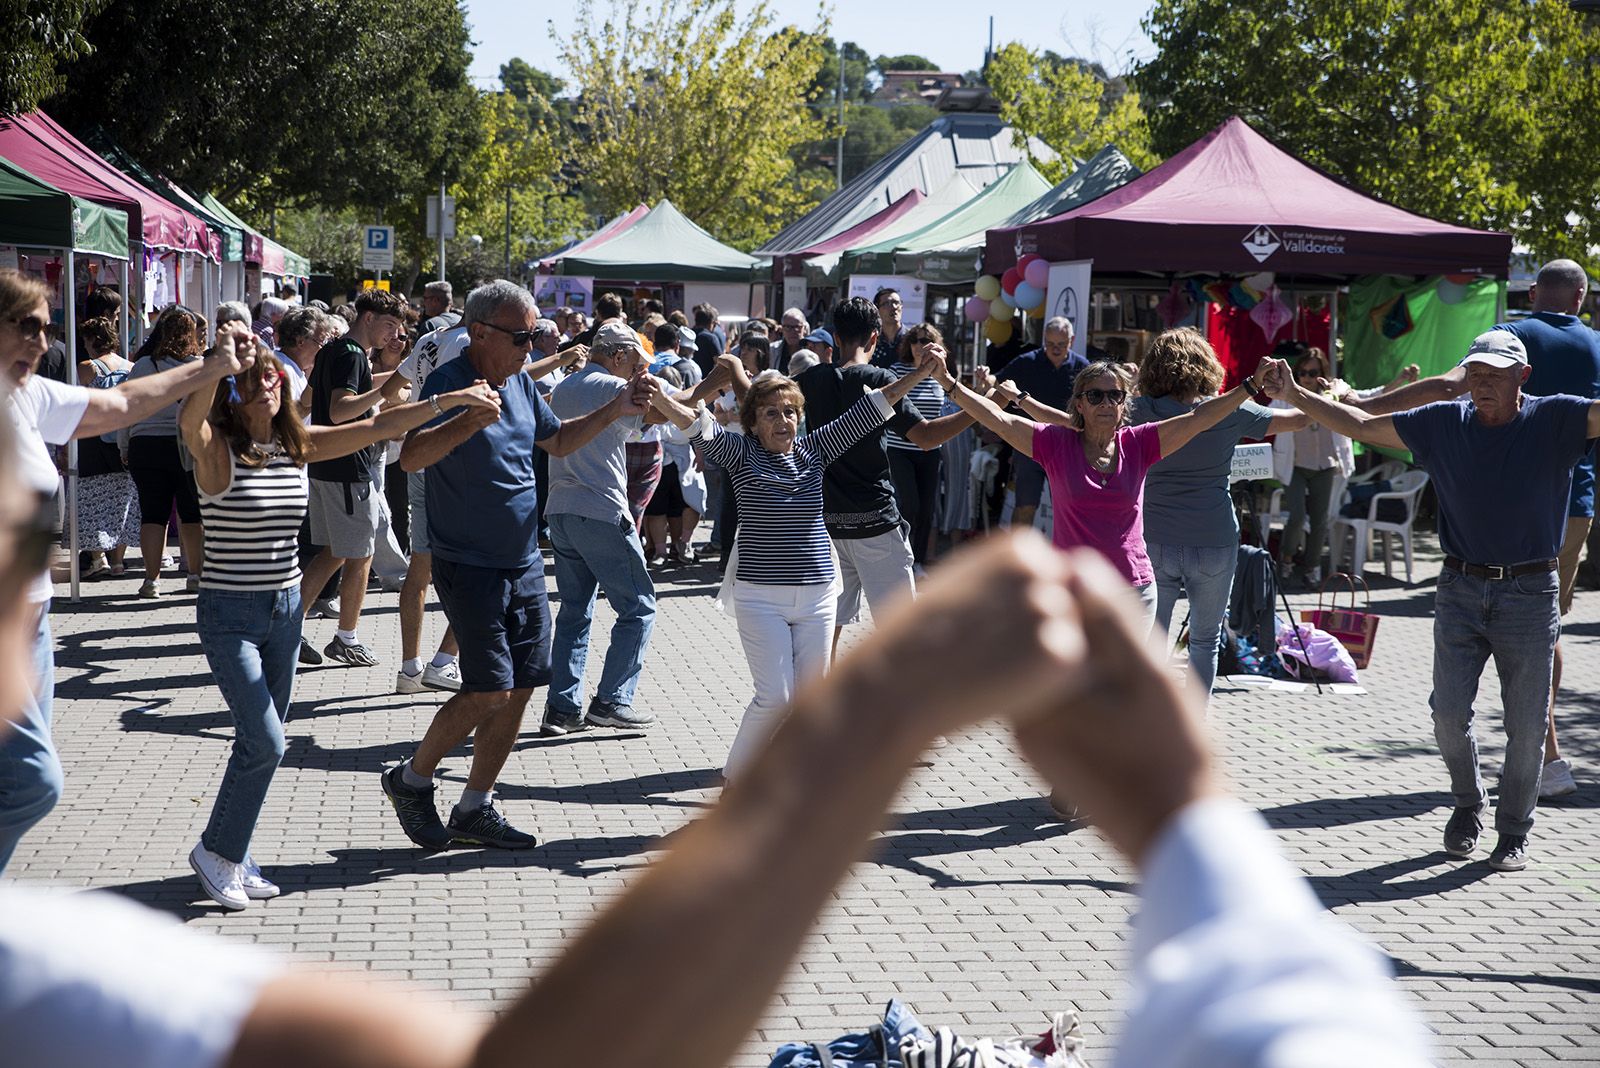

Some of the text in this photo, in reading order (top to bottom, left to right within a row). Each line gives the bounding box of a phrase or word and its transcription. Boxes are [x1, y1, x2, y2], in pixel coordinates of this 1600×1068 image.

[372, 231, 384, 247] P
[1282, 240, 1344, 254] Valldoreix
[1232, 458, 1251, 467] PER
[1230, 467, 1269, 477] ENENTS
